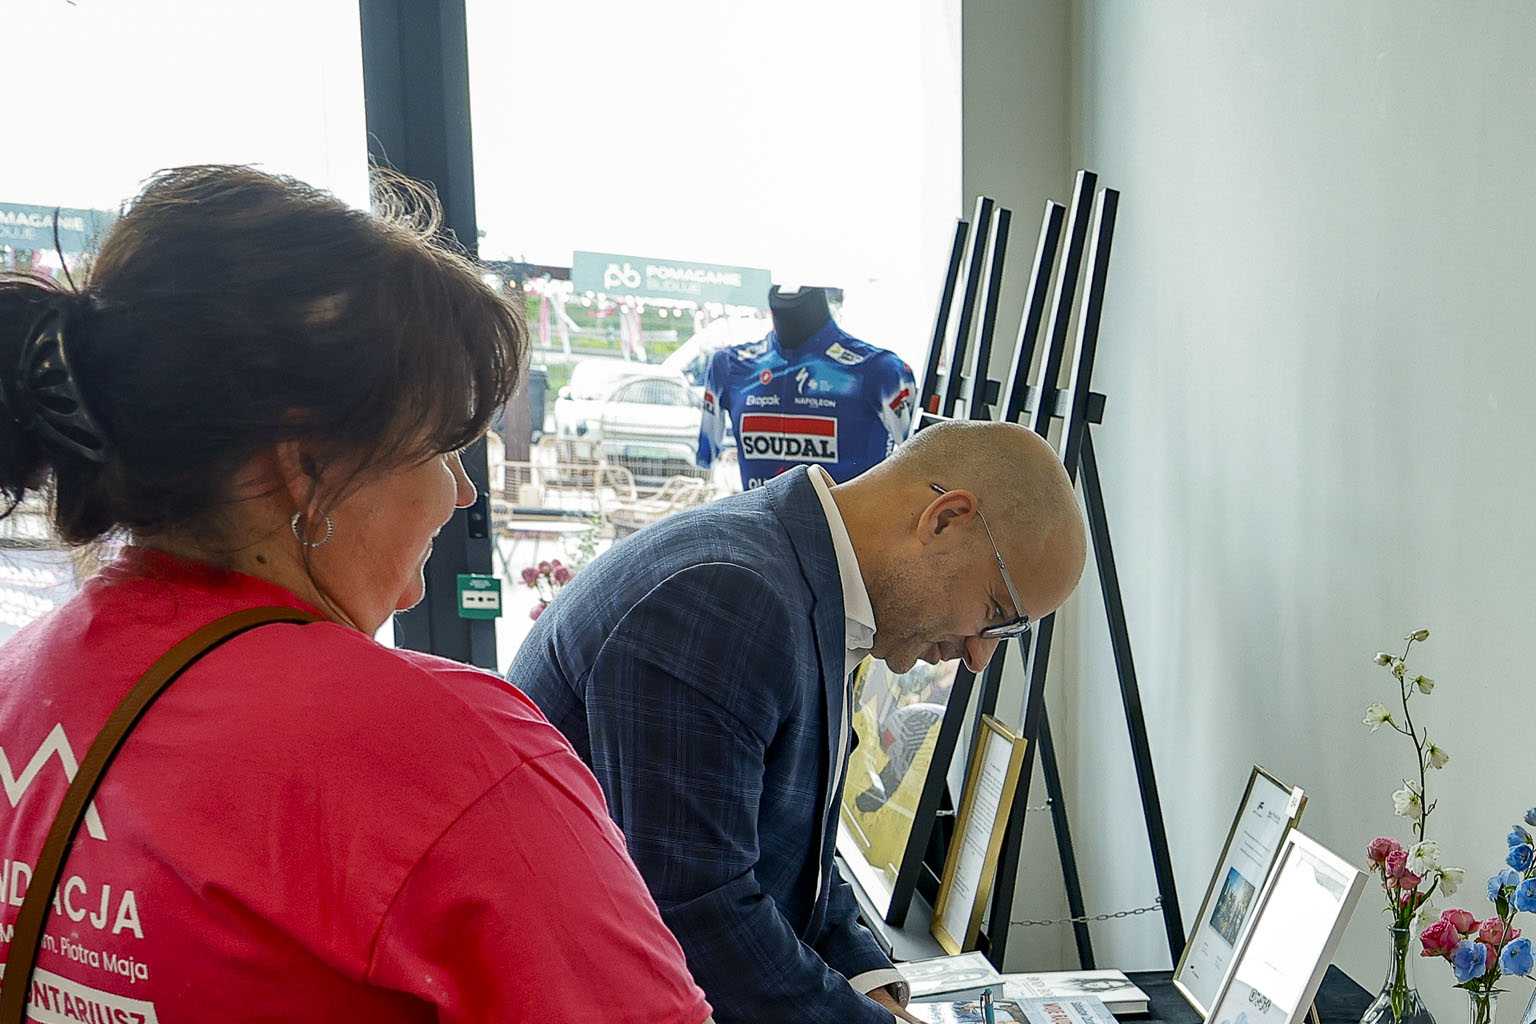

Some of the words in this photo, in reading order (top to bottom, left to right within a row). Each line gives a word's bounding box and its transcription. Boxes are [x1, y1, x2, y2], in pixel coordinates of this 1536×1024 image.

[0, 211, 84, 232] MAGANIE
[645, 264, 742, 288] POMAGANIE
[794, 397, 836, 408] NAPOLEON
[743, 435, 836, 459] SOUDAL
[60, 936, 100, 969] Piotra
[102, 951, 149, 984] Maja
